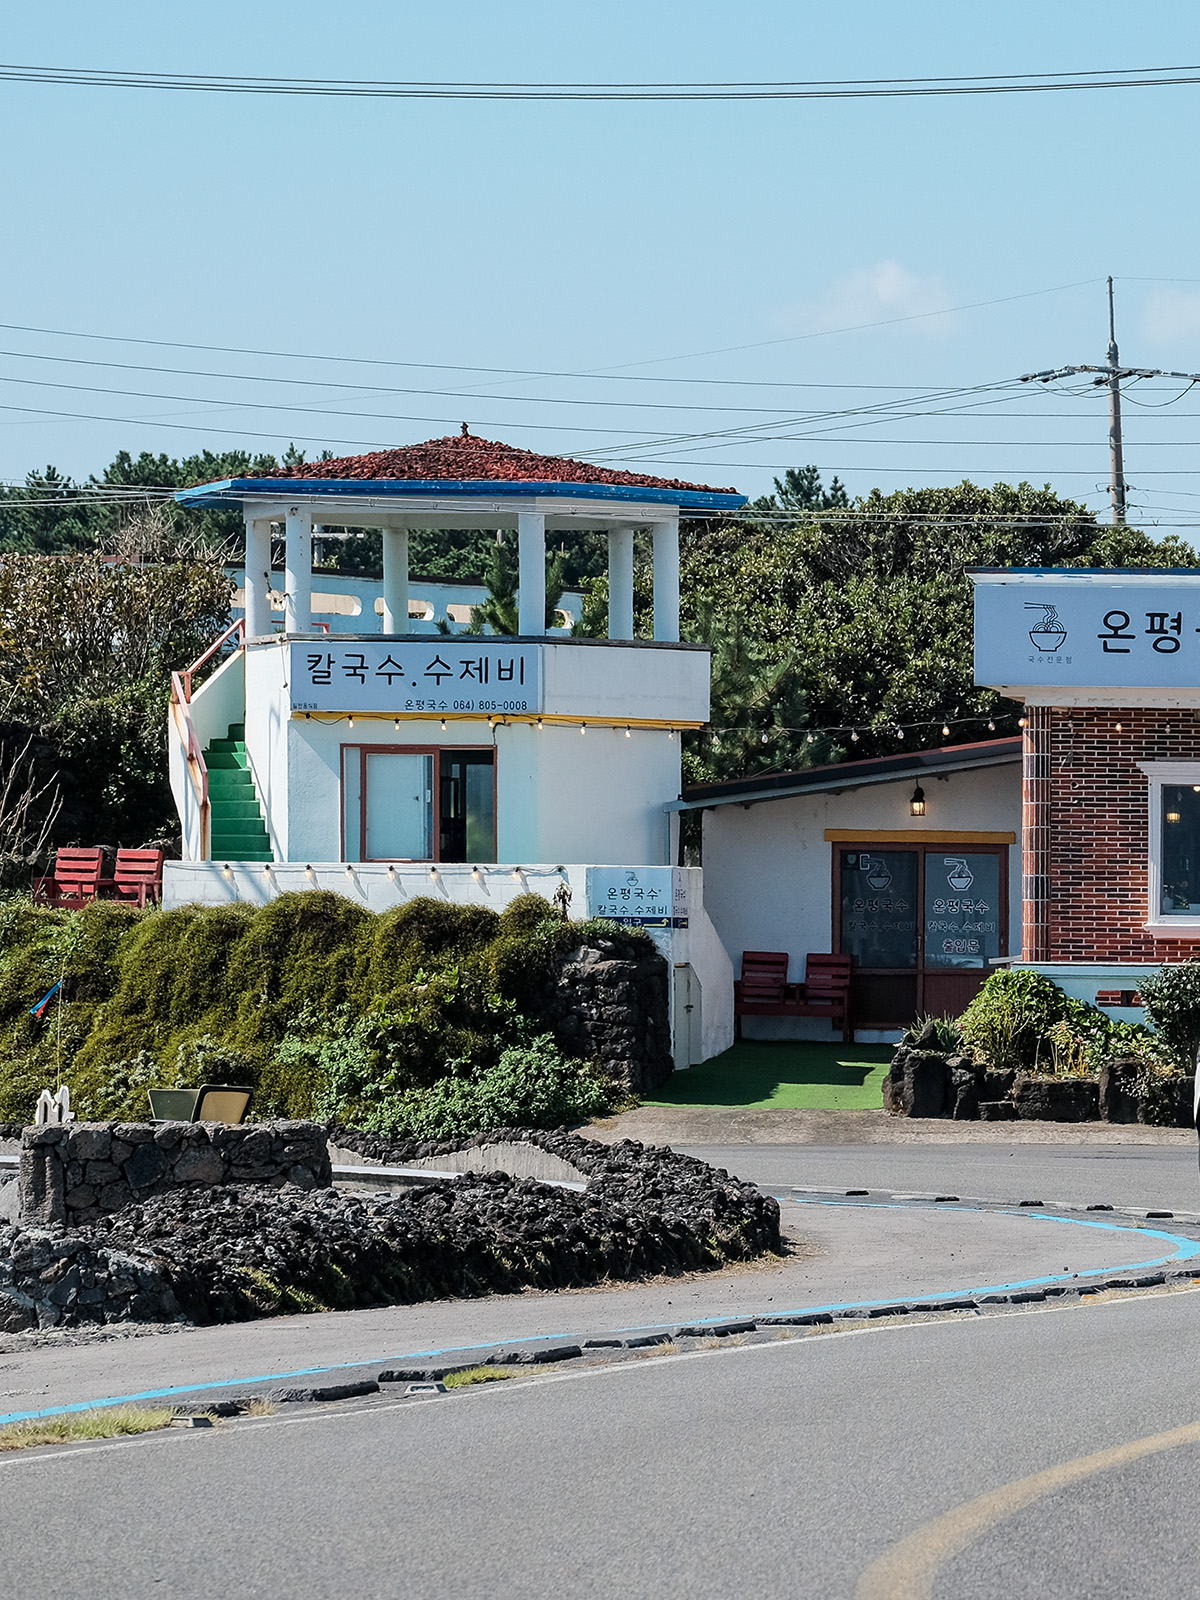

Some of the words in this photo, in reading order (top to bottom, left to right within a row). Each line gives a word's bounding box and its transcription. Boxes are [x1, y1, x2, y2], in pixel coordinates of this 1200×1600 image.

[404, 699, 448, 710] 온평국수
[453, 700, 474, 711] 064)
[479, 700, 527, 711] 805-0008
[607, 887, 658, 900] 온평국수
[853, 898, 909, 913] 온평국수
[932, 898, 990, 914] 온평국수
[942, 938, 980, 953] 출입문
